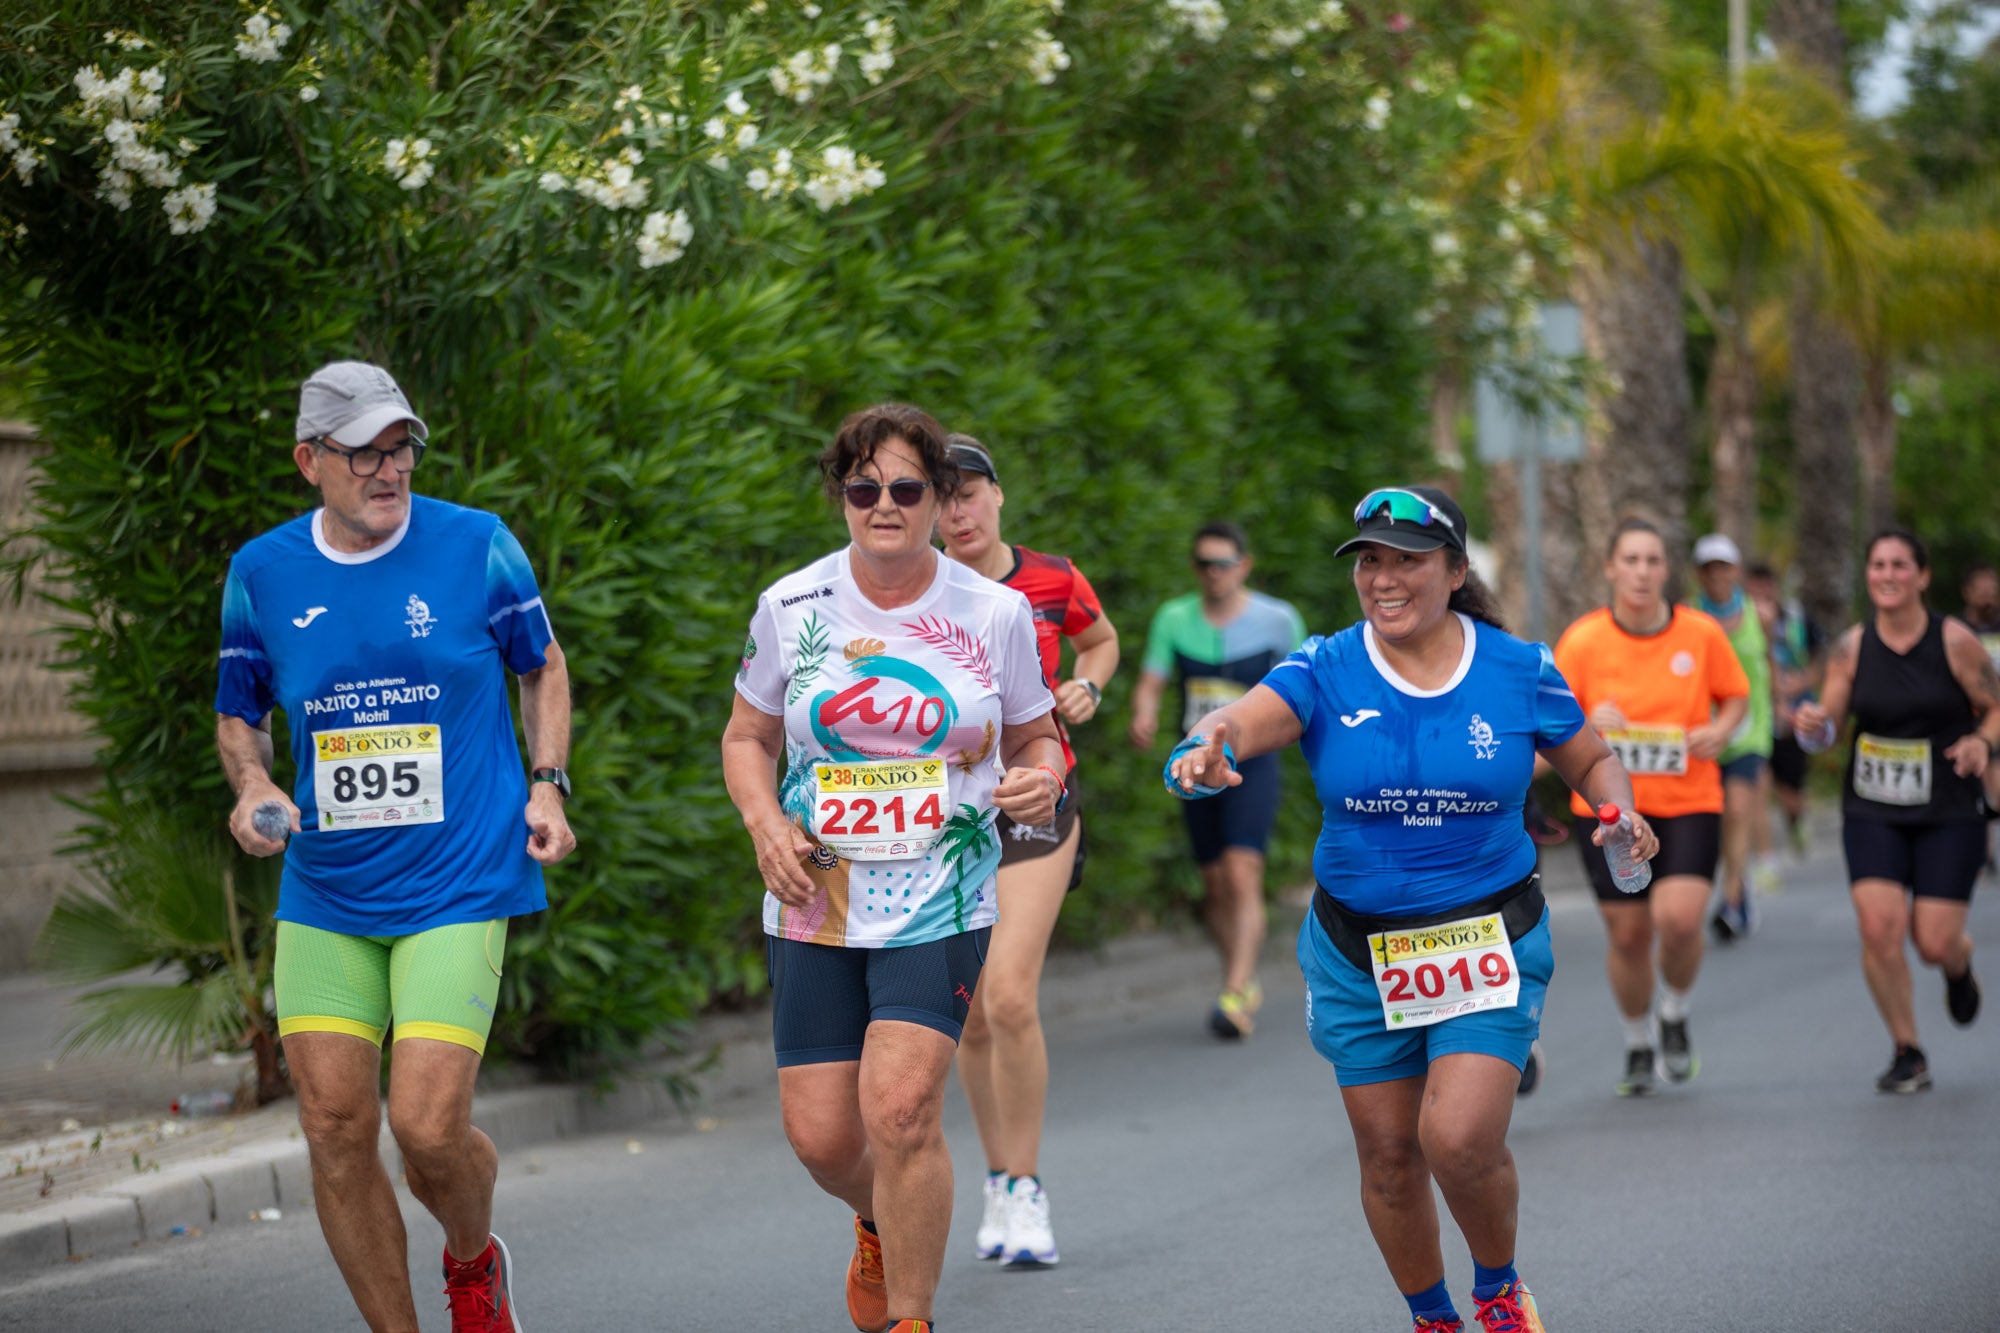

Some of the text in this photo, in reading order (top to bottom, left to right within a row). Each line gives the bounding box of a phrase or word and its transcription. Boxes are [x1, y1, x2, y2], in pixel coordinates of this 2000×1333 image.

[781, 590, 819, 608] luanvi
[334, 677, 406, 692] Club de Atletismo
[304, 684, 440, 716] PAZITO a PAZITO
[353, 709, 390, 724] Motril
[329, 736, 346, 753] 38
[348, 732, 371, 740] GRAN
[346, 735, 412, 753] FONDO
[333, 761, 420, 803] 895
[834, 769, 852, 785] 38
[878, 764, 911, 772] PREMIO
[852, 770, 917, 786] FONDO
[1380, 788, 1467, 799] Club de Atletismo
[820, 793, 944, 835] 2214
[1345, 797, 1498, 813] PAZITO a PAZITO
[1403, 815, 1442, 826] Motril
[1389, 937, 1411, 954] 38
[1413, 932, 1437, 940] GRAN
[1439, 925, 1471, 935] PREMIO
[1412, 931, 1479, 952] FONDO
[1381, 952, 1510, 1003] 2019
